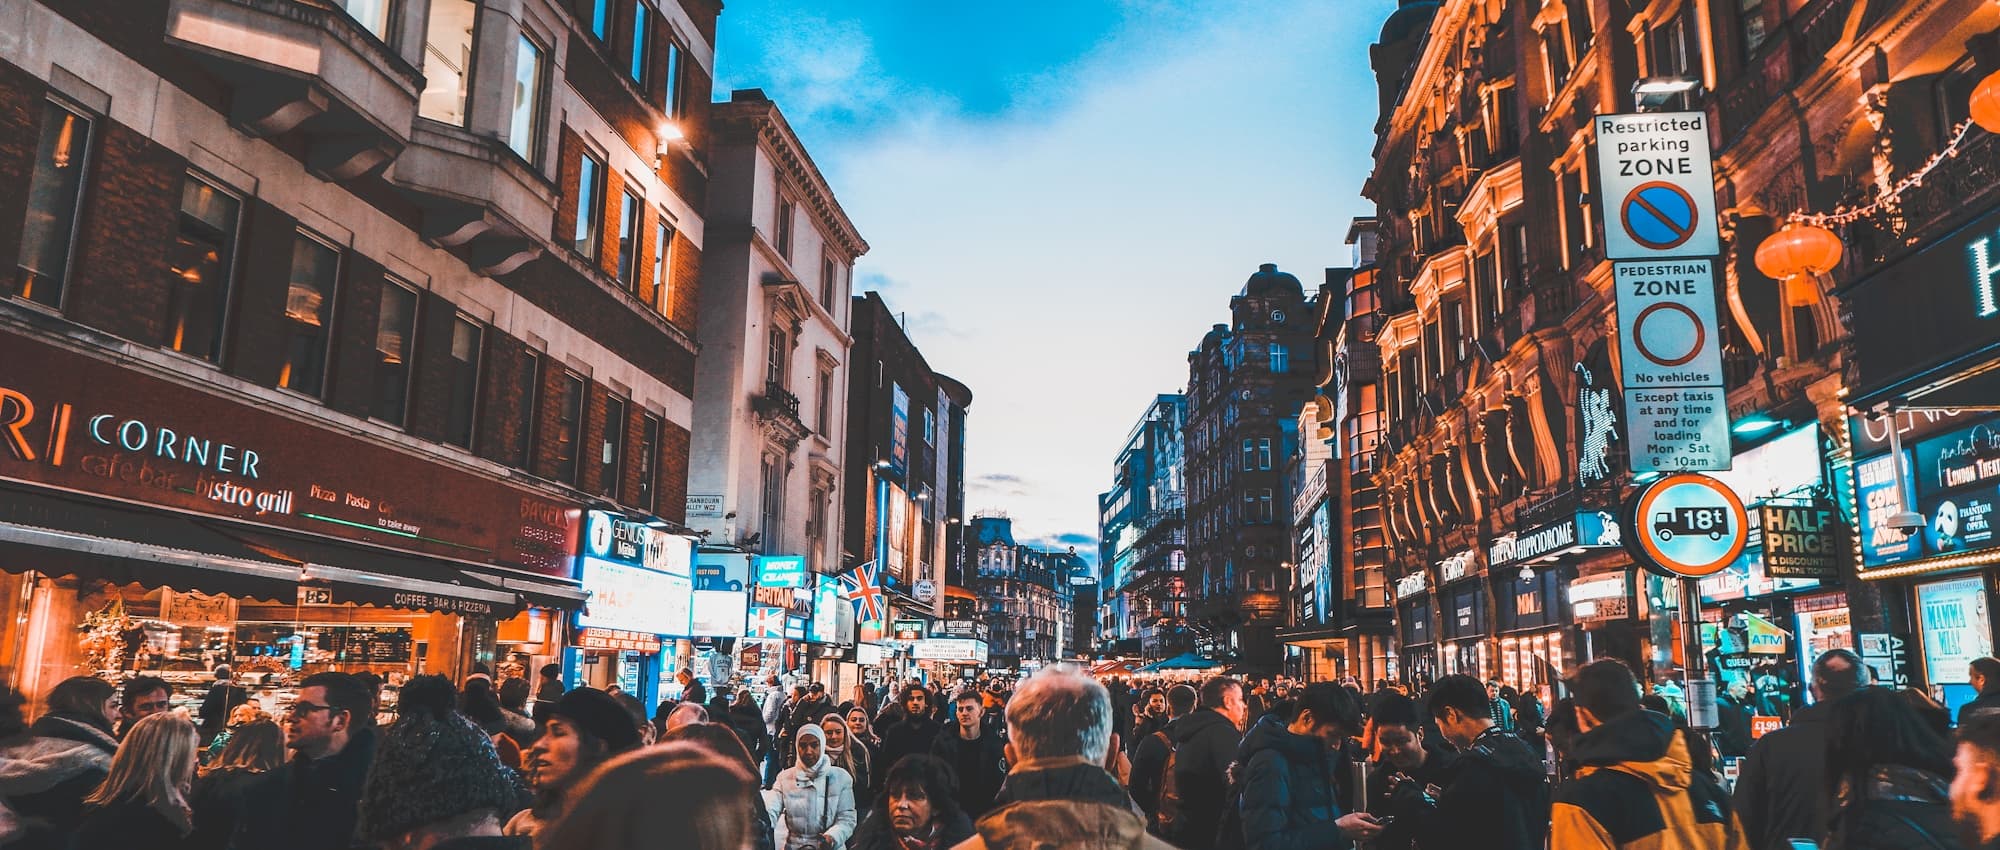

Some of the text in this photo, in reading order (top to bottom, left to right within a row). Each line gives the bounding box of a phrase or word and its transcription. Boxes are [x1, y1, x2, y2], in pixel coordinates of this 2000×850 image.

[1602, 117, 1702, 134] Restricted
[1618, 137, 1690, 155] parking
[1619, 158, 1692, 176] ZONE
[1620, 264, 1706, 277] PEDESTRIAN
[1633, 280, 1696, 296] ZONE
[1636, 372, 1709, 384] No vehicles
[1635, 391, 1714, 405] Except taxis
[1639, 403, 1712, 418] at any time
[1654, 417, 1699, 429] and for
[1655, 430, 1702, 443] loading
[89, 414, 260, 480] CORNER
[1647, 443, 1673, 456] Mon
[1689, 441, 1710, 454] Sat
[1652, 456, 1659, 467] 6
[1675, 455, 1709, 467] 10am
[1946, 464, 1976, 487] LONDON
[197, 477, 256, 507] bistro
[256, 489, 293, 516] grill
[310, 484, 336, 503] Pizza
[345, 492, 371, 511] Pasta
[1866, 486, 1900, 511] COM
[520, 498, 569, 530] BAGELS
[1960, 503, 1992, 518] PHANTOM
[378, 517, 420, 536] to take away
[1684, 508, 1722, 531] 18t
[1766, 509, 1831, 532] HALF
[1966, 519, 1989, 532] OPERA
[612, 519, 645, 545] GENIUS
[1516, 521, 1574, 561] HIPPODROME
[1768, 533, 1836, 554] PRICE
[765, 561, 800, 571] MONEY
[1770, 556, 1778, 566] &
[761, 571, 802, 588] CHANGE
[1770, 566, 1806, 576] THEATRE
[394, 591, 427, 606] COFFEE
[434, 597, 449, 609] BAR
[451, 600, 456, 610] &
[459, 601, 491, 614] PIZZERIA
[756, 584, 794, 610] BRITAIN
[946, 620, 972, 628] MOTOWN
[1813, 614, 1848, 627] ATM HERE
[1926, 603, 1967, 631] MAMMA
[1751, 633, 1783, 645] ATM
[1891, 636, 1906, 671] ALL
[1726, 659, 1751, 667] QUEEN
[1754, 720, 1778, 735] £1.99
